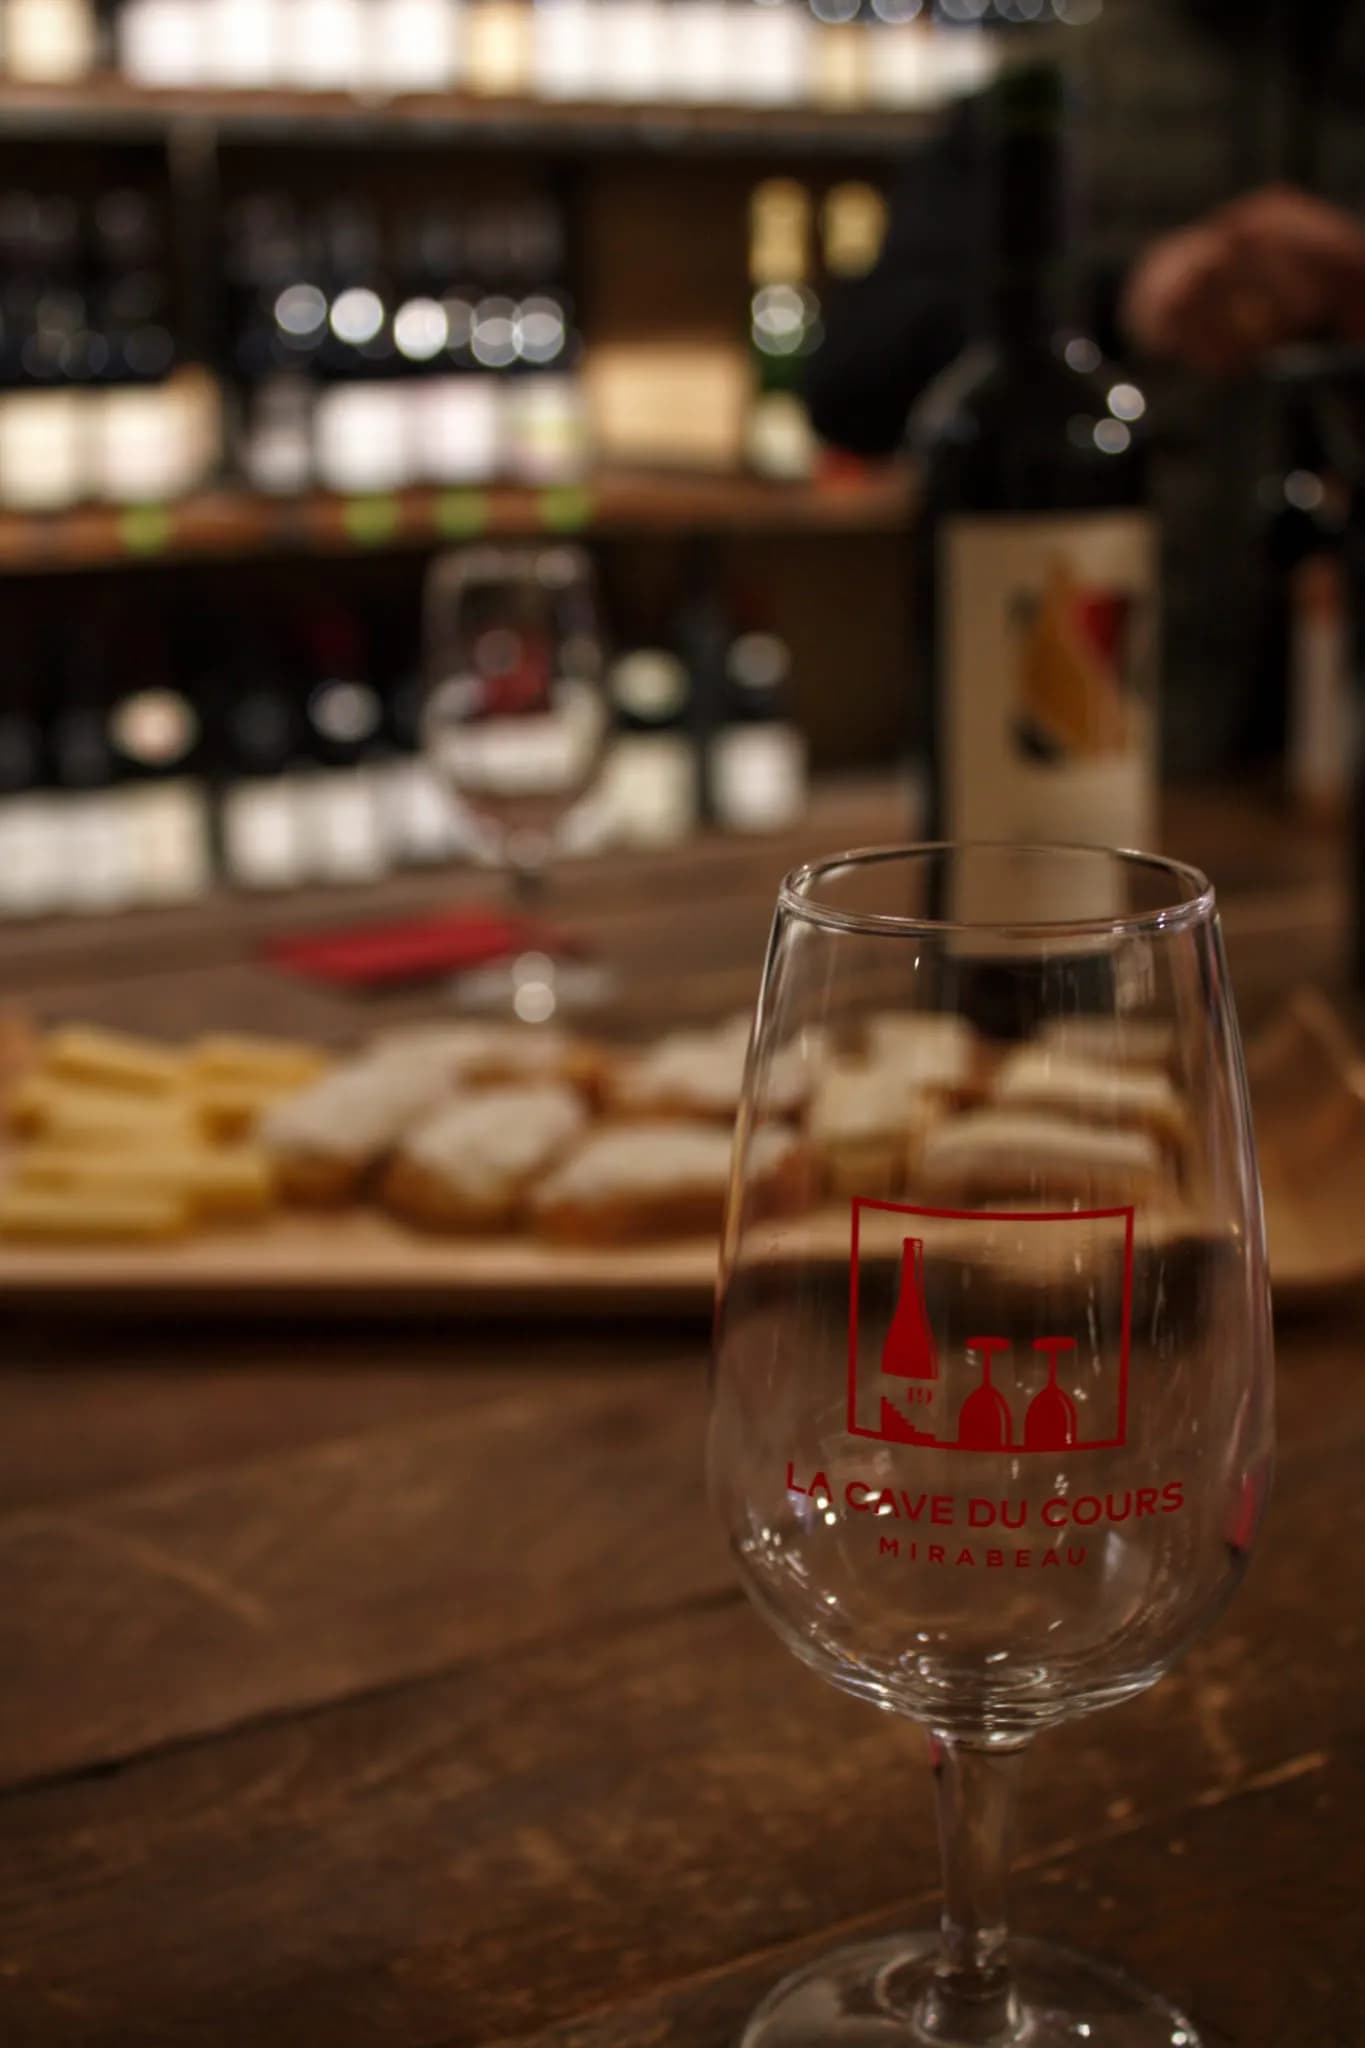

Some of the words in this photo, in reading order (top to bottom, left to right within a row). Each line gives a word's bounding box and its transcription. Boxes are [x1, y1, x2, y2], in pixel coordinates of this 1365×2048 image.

[786, 1461, 832, 1504] LA
[845, 1481, 954, 1525] CAVE
[968, 1498, 1026, 1528] DU
[1041, 1482, 1184, 1527] COURS
[879, 1536, 1086, 1567] MIRABEAU
